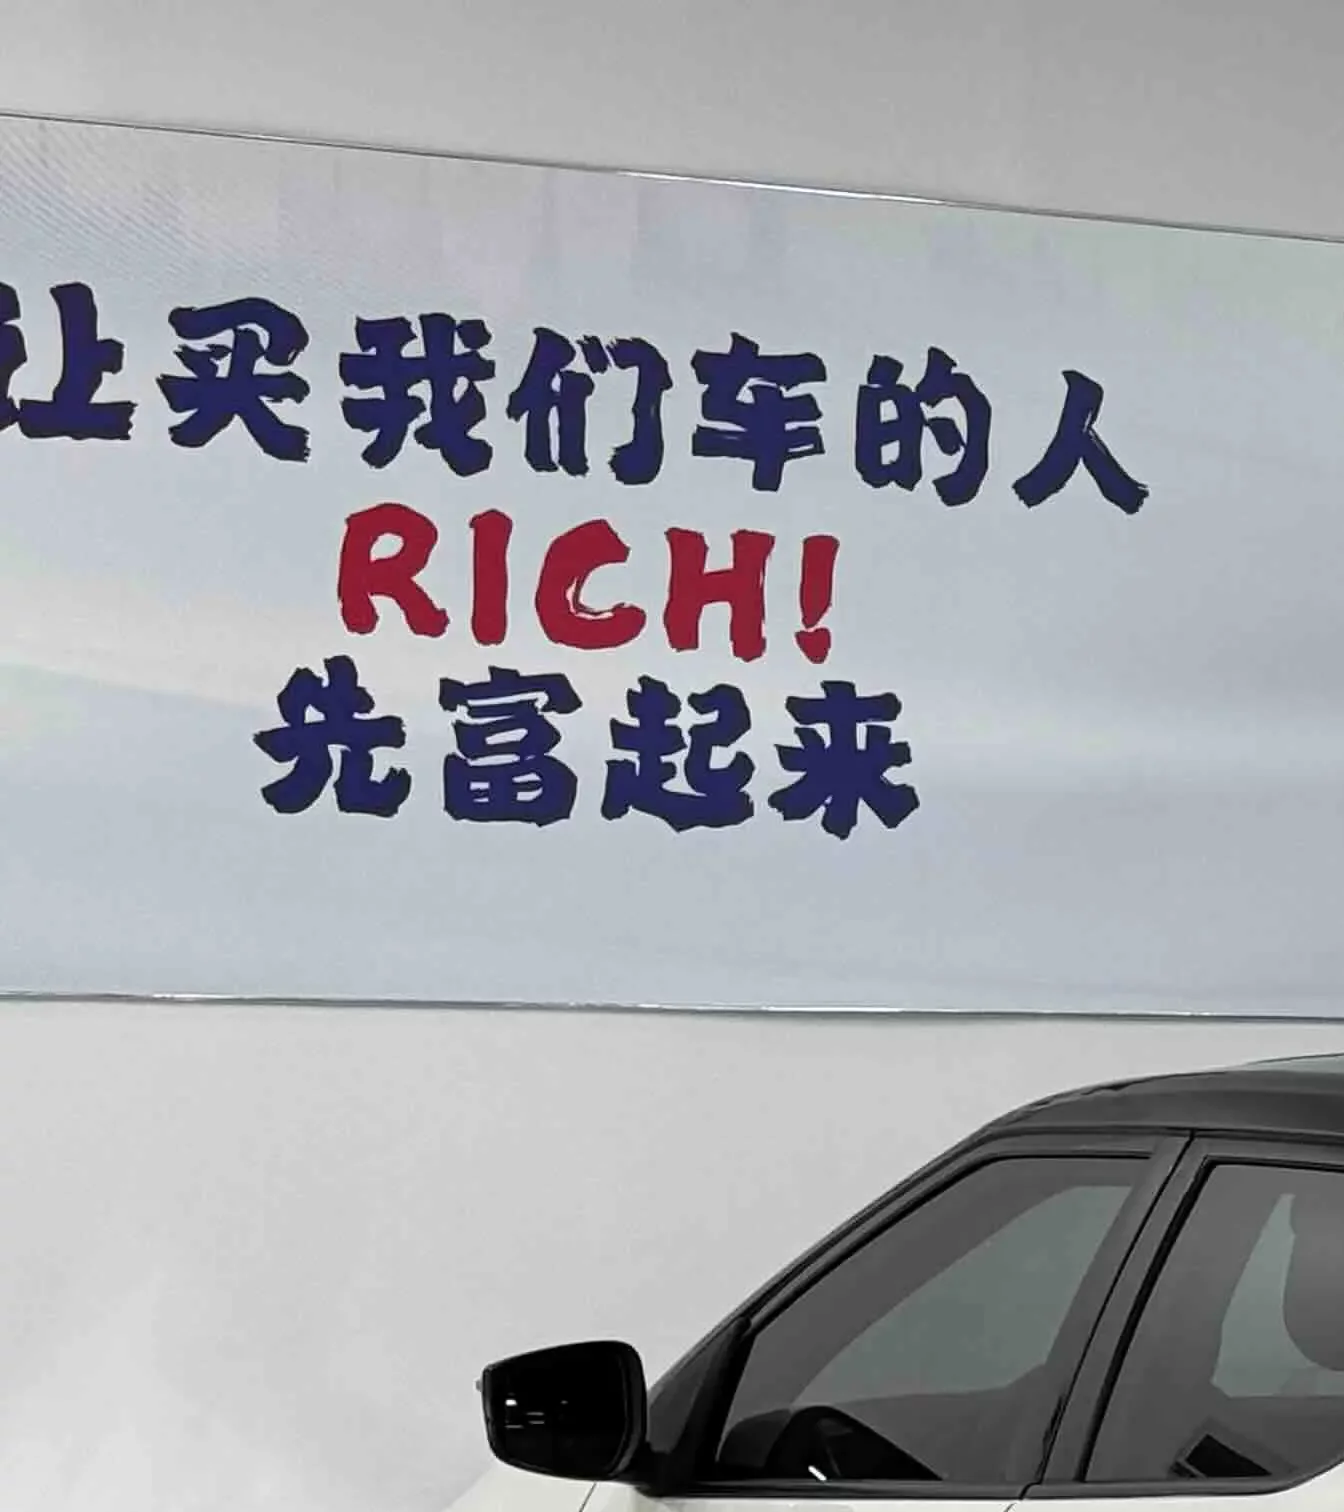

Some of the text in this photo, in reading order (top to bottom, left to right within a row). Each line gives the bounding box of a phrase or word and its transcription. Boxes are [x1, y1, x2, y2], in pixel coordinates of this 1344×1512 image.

[0, 281, 1150, 515] 让买我们车的人
[337, 503, 841, 664] RICH!
[253, 656, 920, 840] 先富起来
